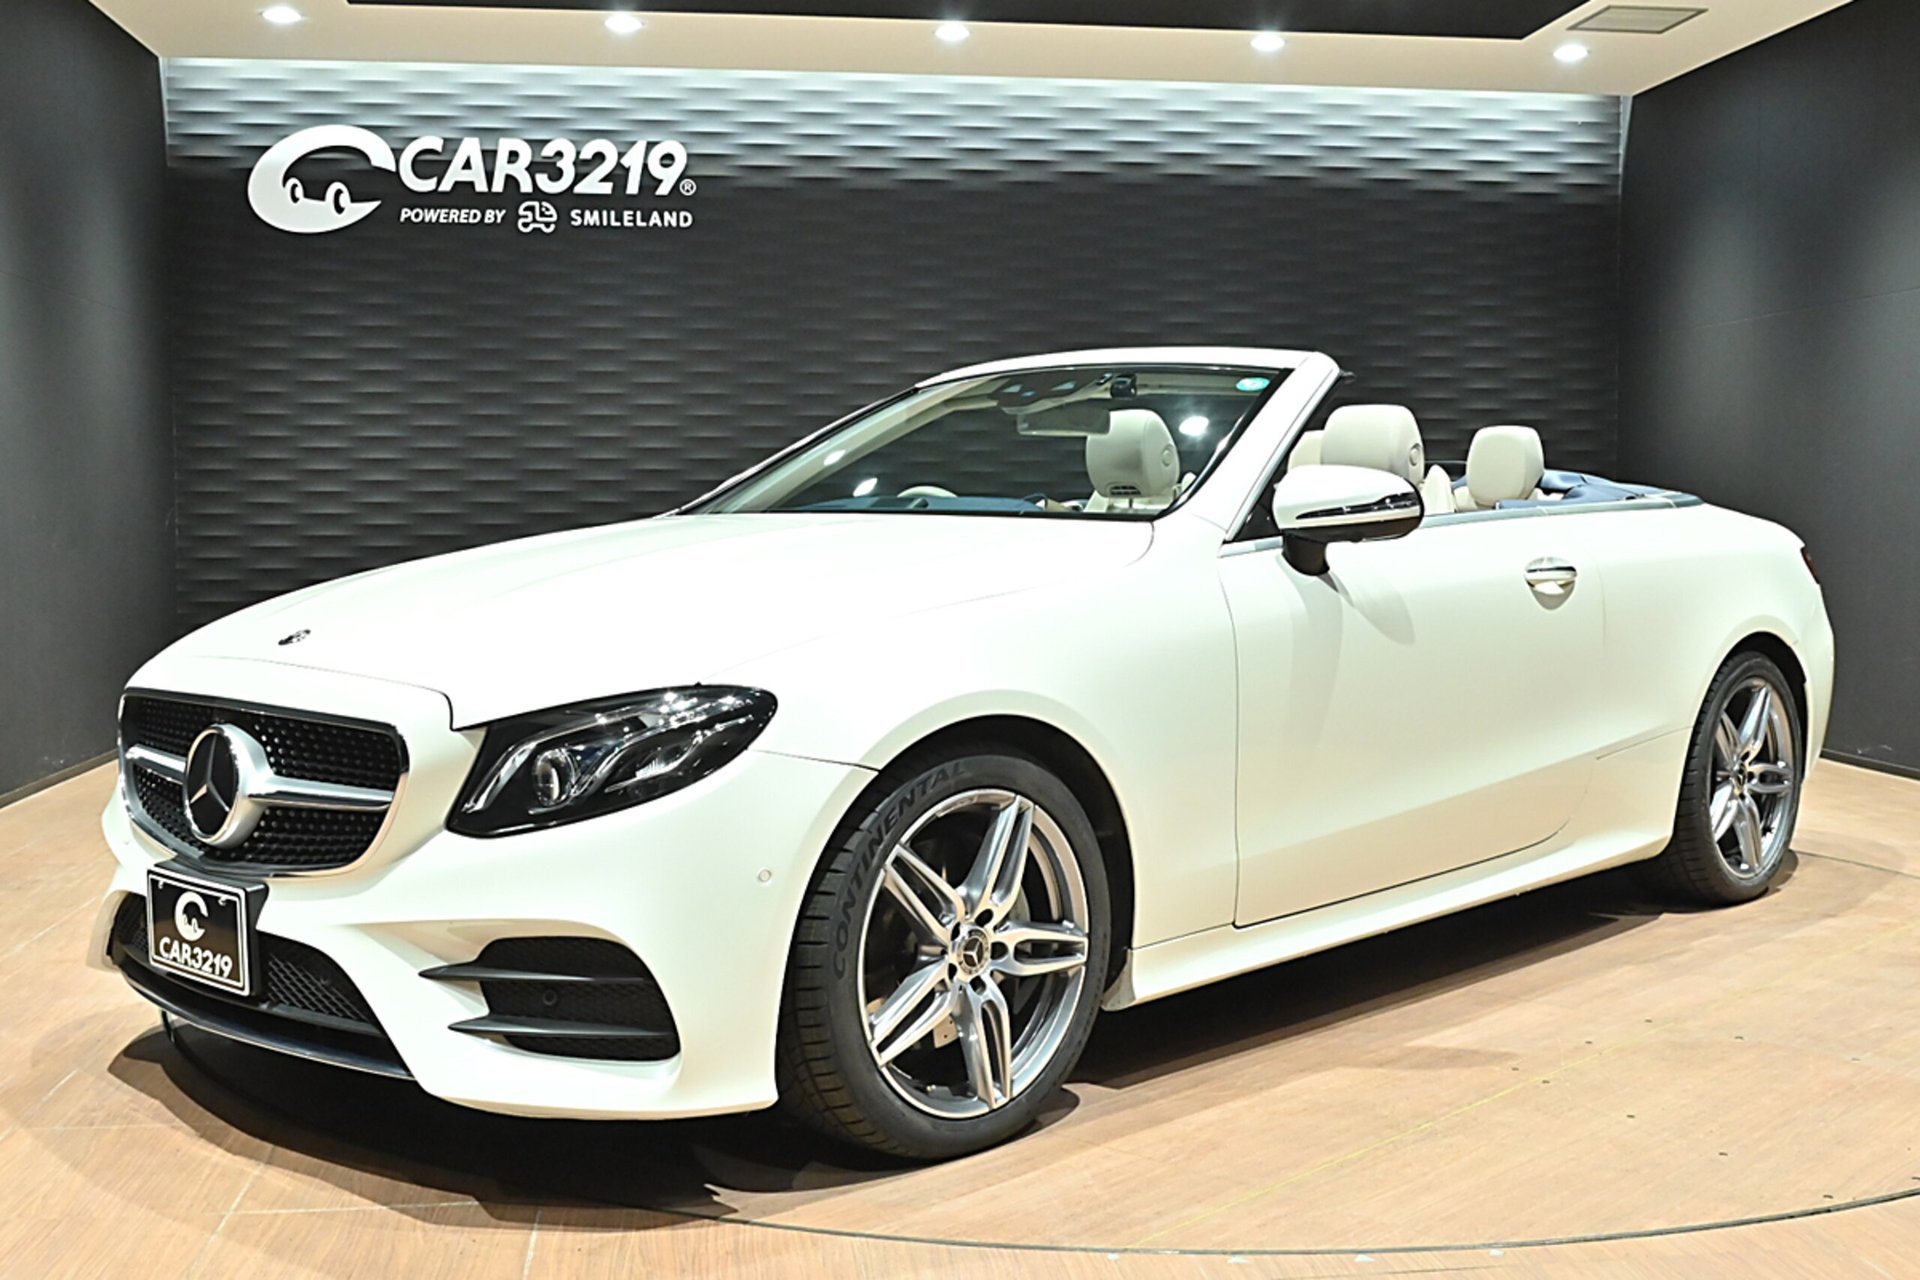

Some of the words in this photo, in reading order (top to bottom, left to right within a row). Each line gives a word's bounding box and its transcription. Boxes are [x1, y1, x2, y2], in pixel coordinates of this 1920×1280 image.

[400, 207, 482, 223] POWERED
[484, 208, 506, 224] BY
[571, 208, 692, 228] SMILELAND
[833, 763, 967, 978] CONTINENTAL
[159, 936, 233, 978] CAR3219
